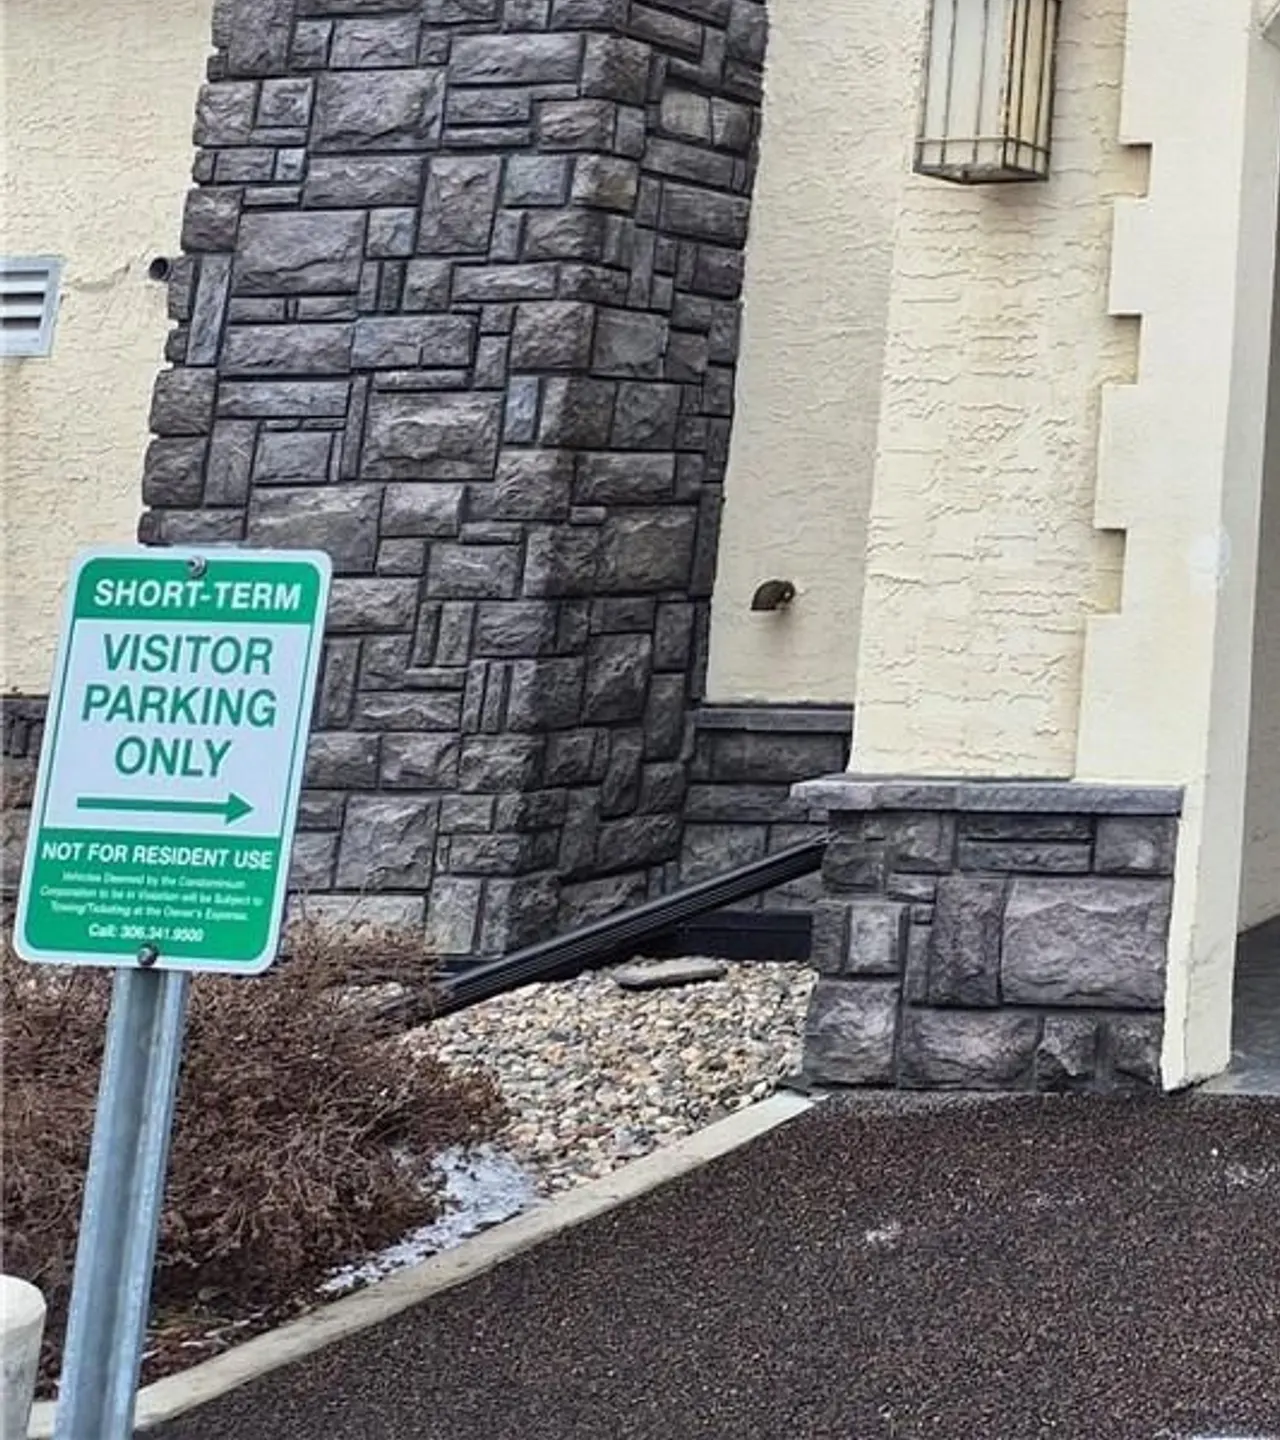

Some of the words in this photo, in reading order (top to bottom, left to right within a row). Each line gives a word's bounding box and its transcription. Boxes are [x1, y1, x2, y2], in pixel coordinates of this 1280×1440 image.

[93, 578, 303, 610] SHORT-TERM
[103, 632, 274, 675] VISITOR
[81, 683, 278, 728] PARKING
[114, 735, 233, 777] ONLY
[41, 841, 85, 861] NOT
[87, 842, 129, 864] FOR
[132, 844, 229, 868] RESIDENT
[233, 848, 273, 870] USE
